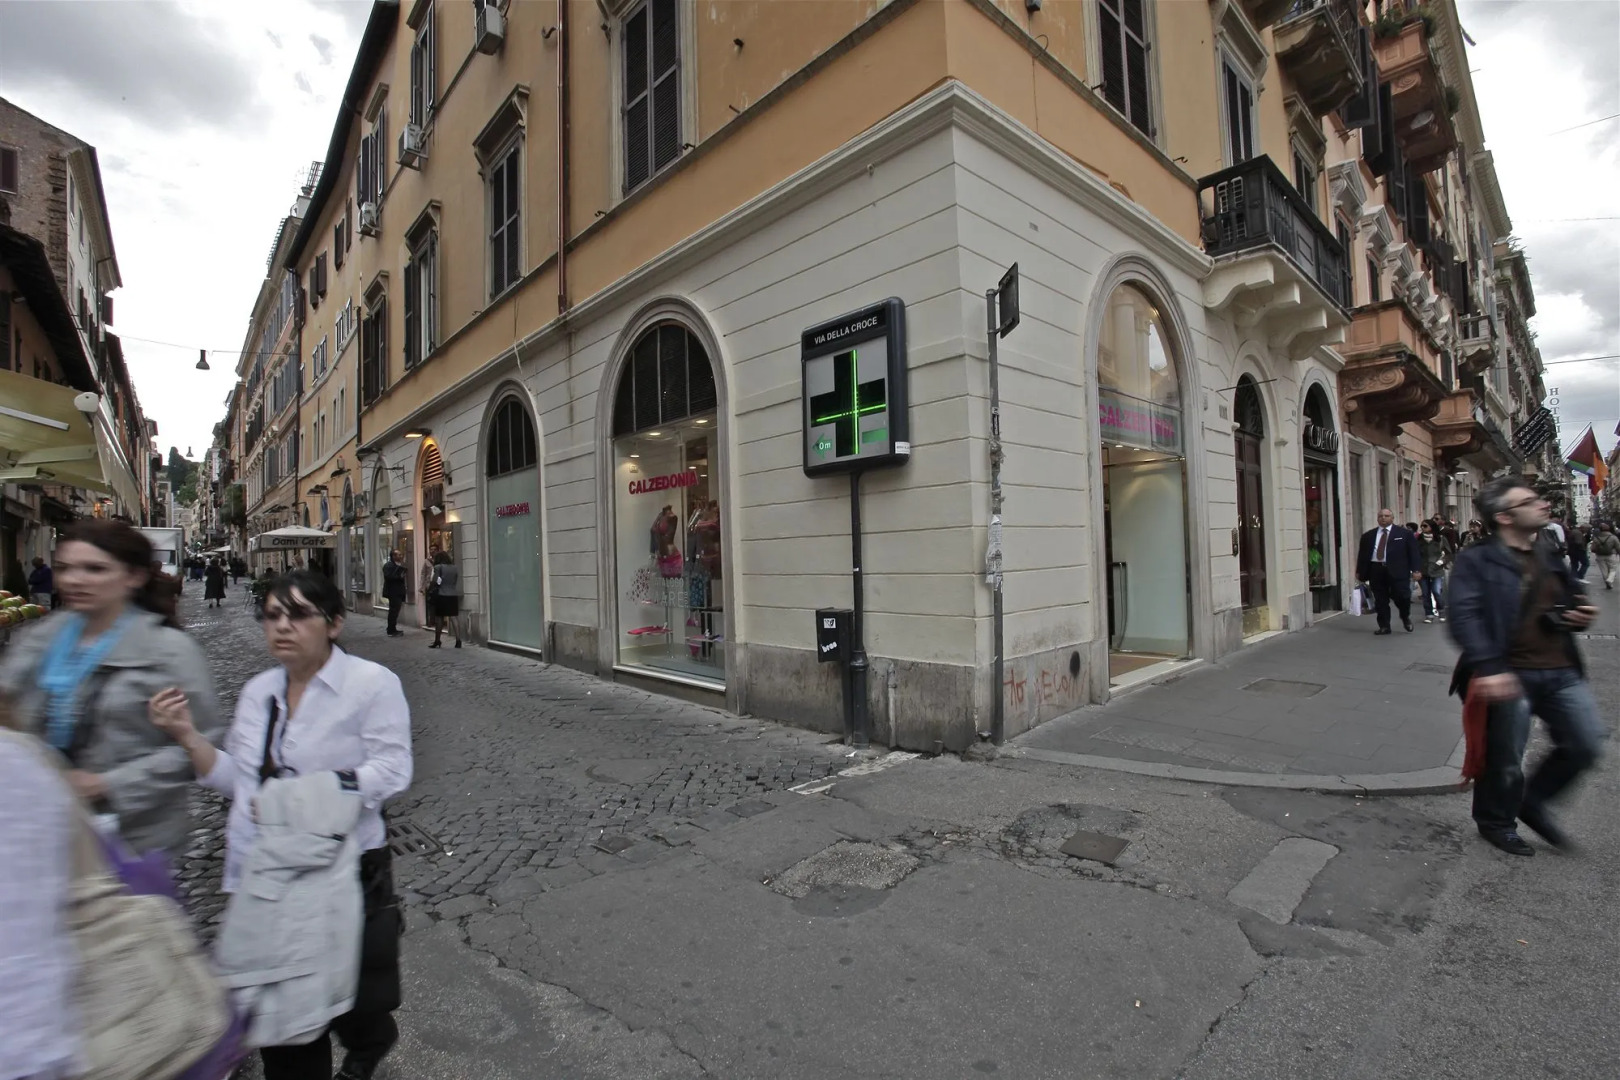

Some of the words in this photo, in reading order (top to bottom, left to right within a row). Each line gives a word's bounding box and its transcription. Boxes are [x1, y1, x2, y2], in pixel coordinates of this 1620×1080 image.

[814, 333, 826, 345] VIA
[826, 326, 850, 341] DELLA
[851, 316, 878, 333] CROCE
[629, 470, 699, 495] CALZEDONIA
